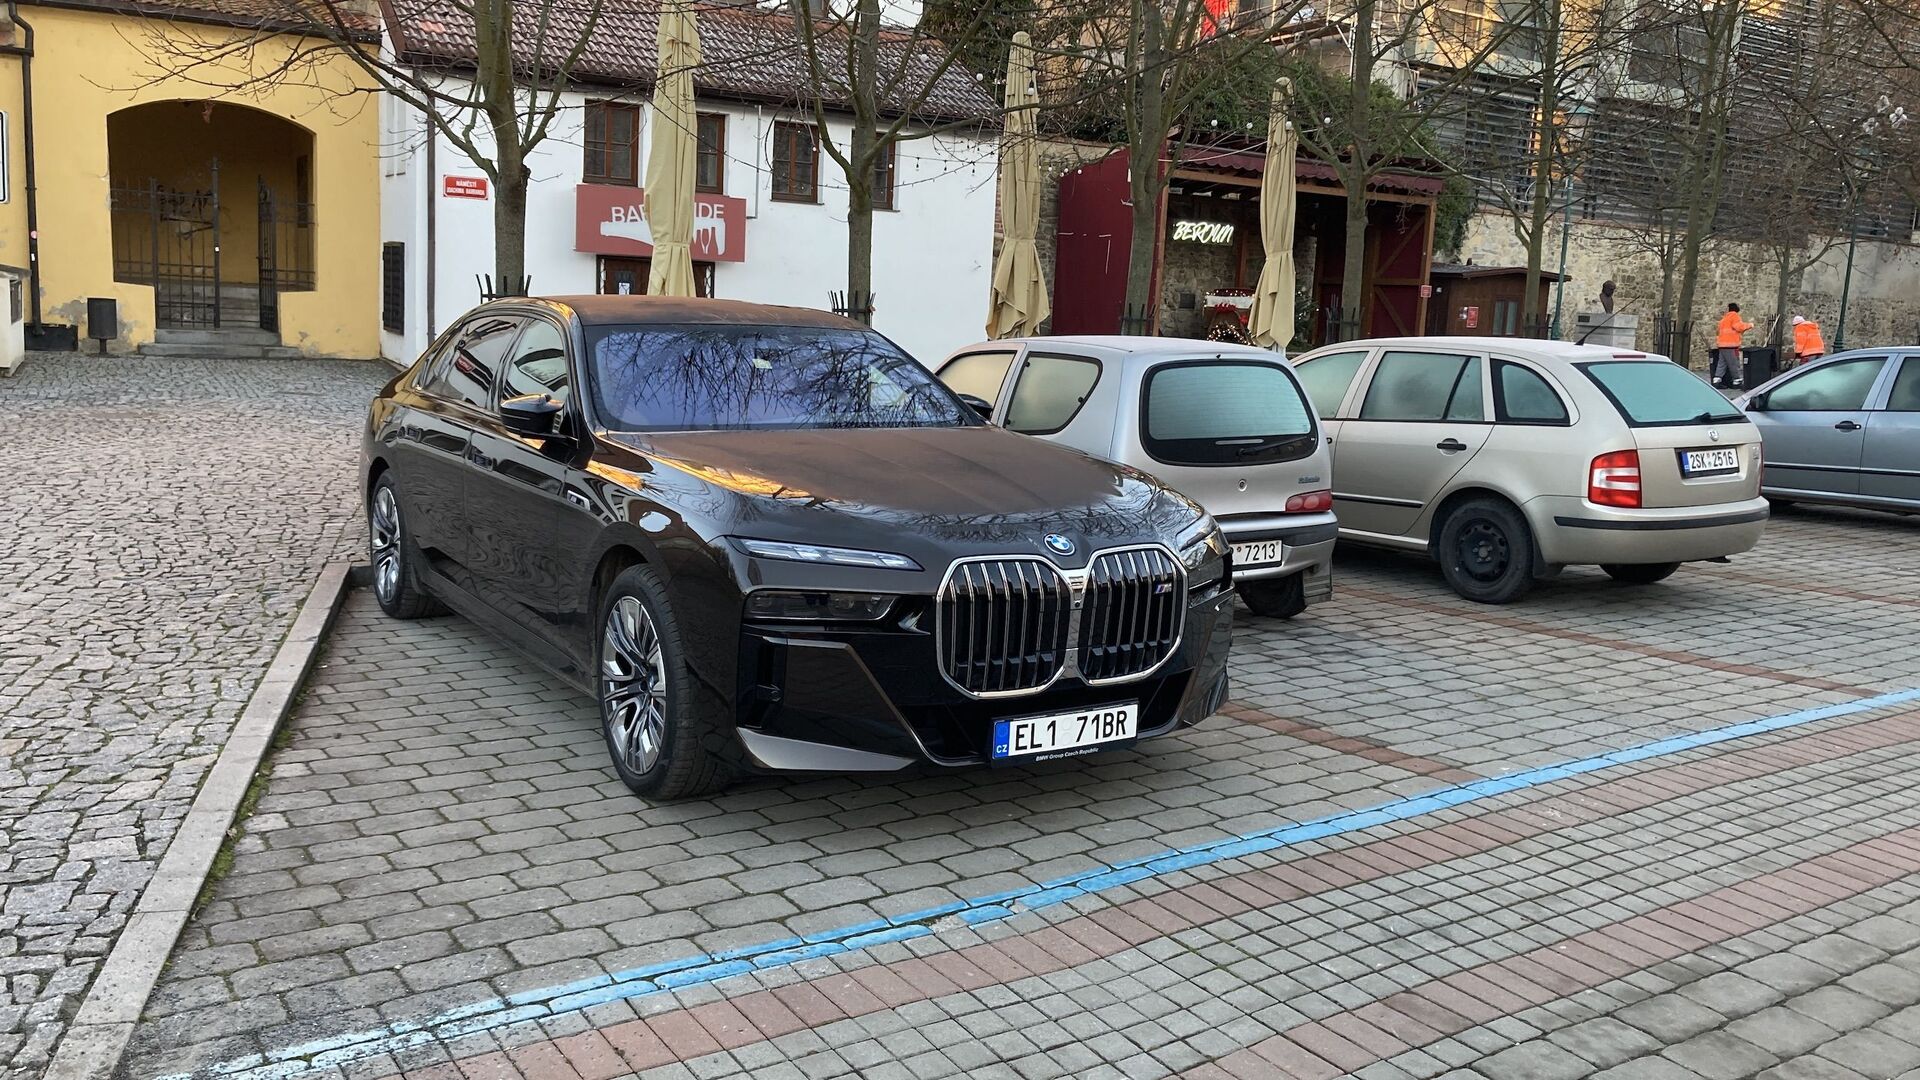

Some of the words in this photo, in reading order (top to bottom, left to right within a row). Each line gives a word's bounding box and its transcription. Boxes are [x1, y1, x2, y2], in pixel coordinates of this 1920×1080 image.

[1172, 221, 1234, 243] BEROUN
[1690, 453, 1707, 469] 2SK
[1712, 451, 1734, 467] 2516
[1245, 543, 1276, 562] 7213
[1015, 720, 1057, 750] EL1
[1076, 710, 1128, 742] 71BR
[996, 744, 1007, 753] CZ
[1079, 747, 1099, 755] Republic
